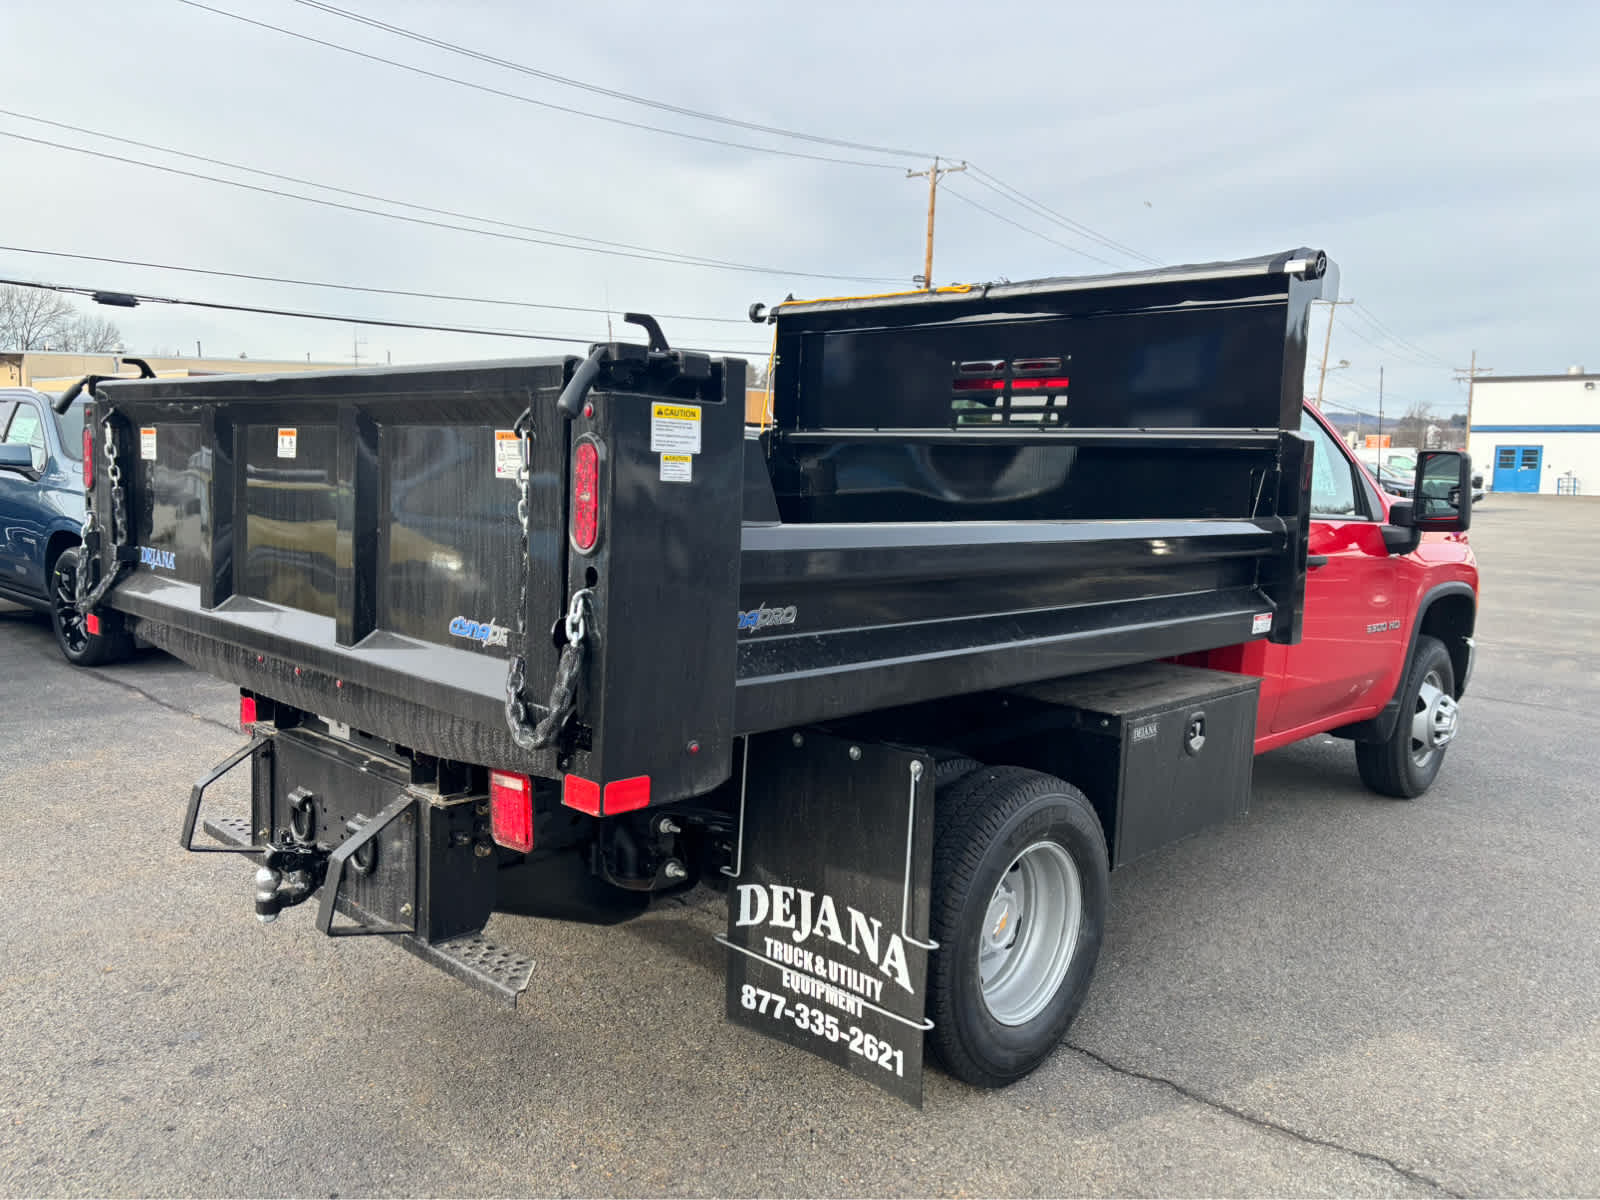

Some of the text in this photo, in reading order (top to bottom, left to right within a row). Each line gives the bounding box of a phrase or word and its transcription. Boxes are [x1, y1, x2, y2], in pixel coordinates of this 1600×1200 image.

[664, 408, 697, 418] CAUTION
[140, 546, 176, 570] DEJANA
[736, 884, 915, 994] DEJANA
[764, 936, 883, 1002] TRUCK & UTILITY
[782, 969, 865, 1018] EQUIPMENT
[741, 984, 904, 1077] 877-335-2621
